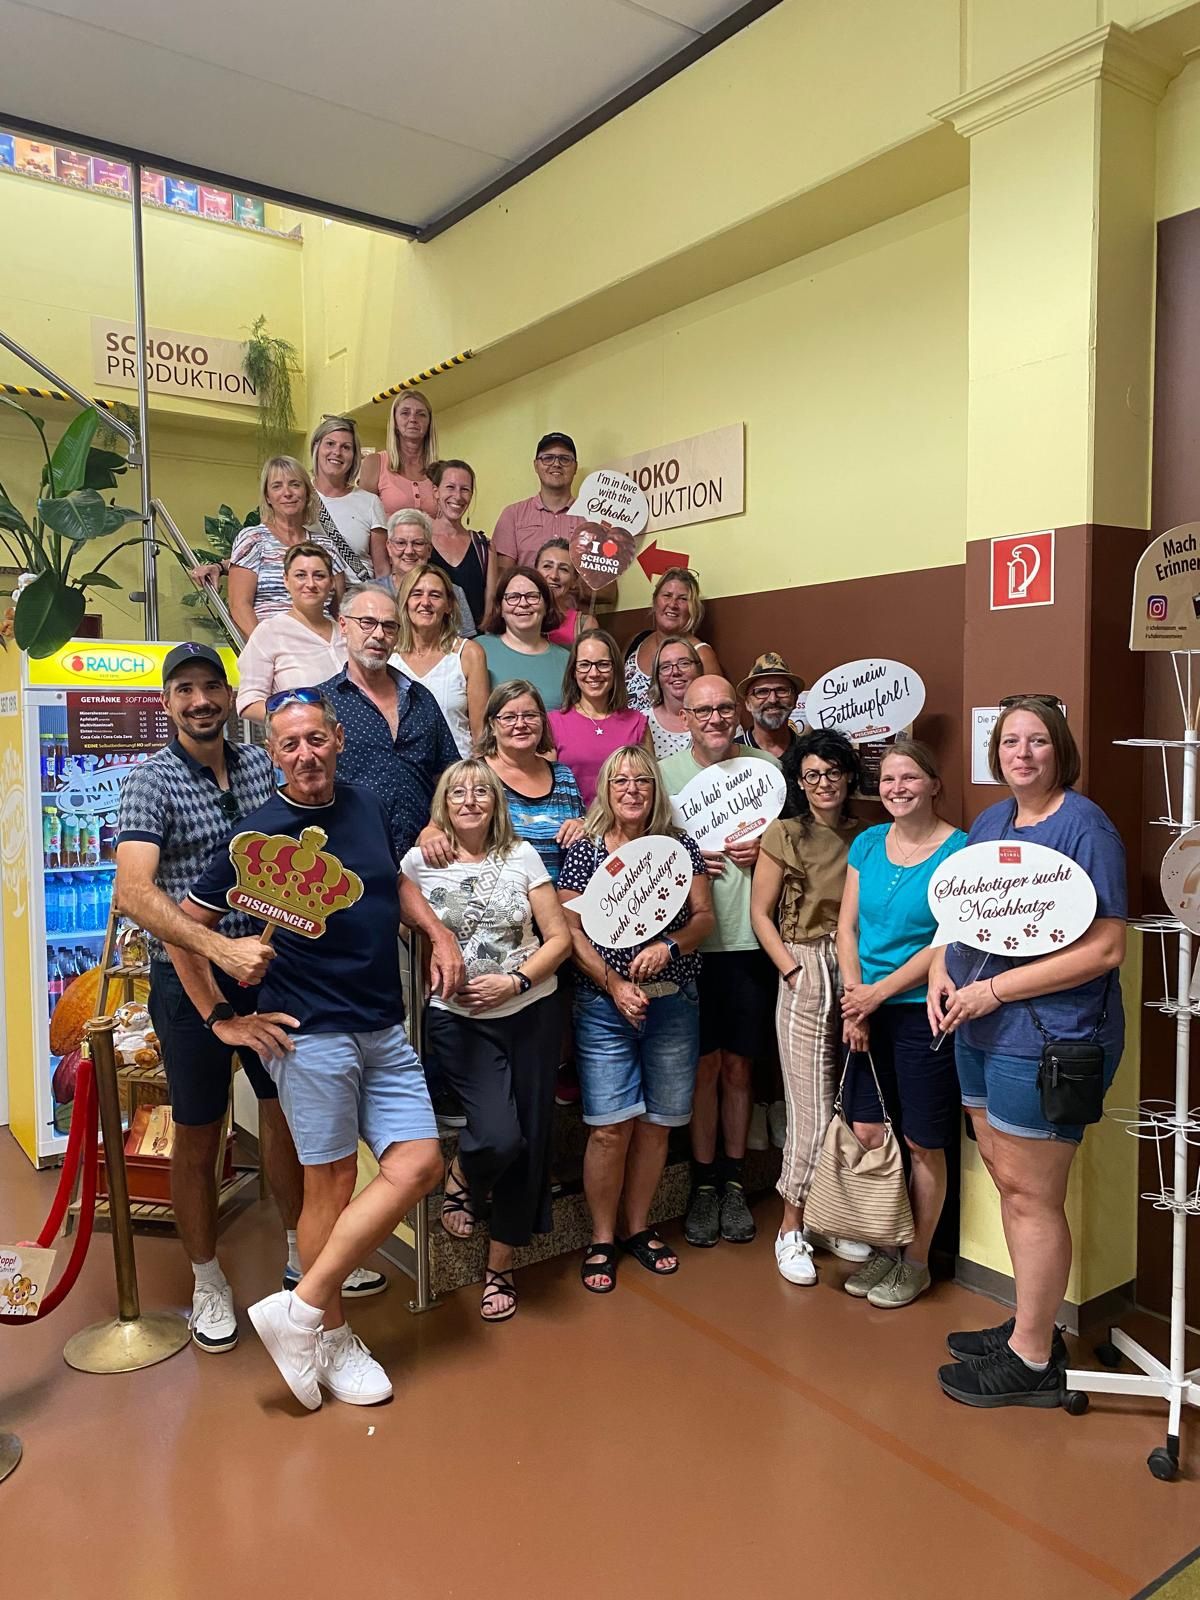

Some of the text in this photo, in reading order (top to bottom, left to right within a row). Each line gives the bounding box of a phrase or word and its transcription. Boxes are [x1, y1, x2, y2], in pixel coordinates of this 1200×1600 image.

[106, 332, 209, 366] SCHOKO
[597, 472, 638, 494] I'm in love
[625, 459, 680, 492] OKO
[586, 497, 640, 524] Schoko!
[598, 488, 632, 505] with the
[646, 476, 722, 518] UKTION
[580, 553, 620, 568] SCHOKO
[591, 541, 600, 554] I
[1162, 533, 1197, 559] Mach
[580, 560, 619, 575] MARONI
[86, 656, 145, 673] RAUCH
[823, 663, 887, 700] Sei mein
[81, 695, 121, 704] GETRÄNKE
[125, 696, 142, 704] SOFT
[680, 798, 702, 823] Ich
[725, 768, 752, 791] einen
[695, 774, 774, 840] an der Waffel!
[600, 851, 653, 918] Naschkatze
[609, 914, 631, 945] sucht
[627, 850, 678, 917] Schokotiger
[934, 864, 1073, 903] Schokotiger sucht
[236, 893, 315, 932] PISCHINGER
[959, 897, 1056, 923] Naschkatze
